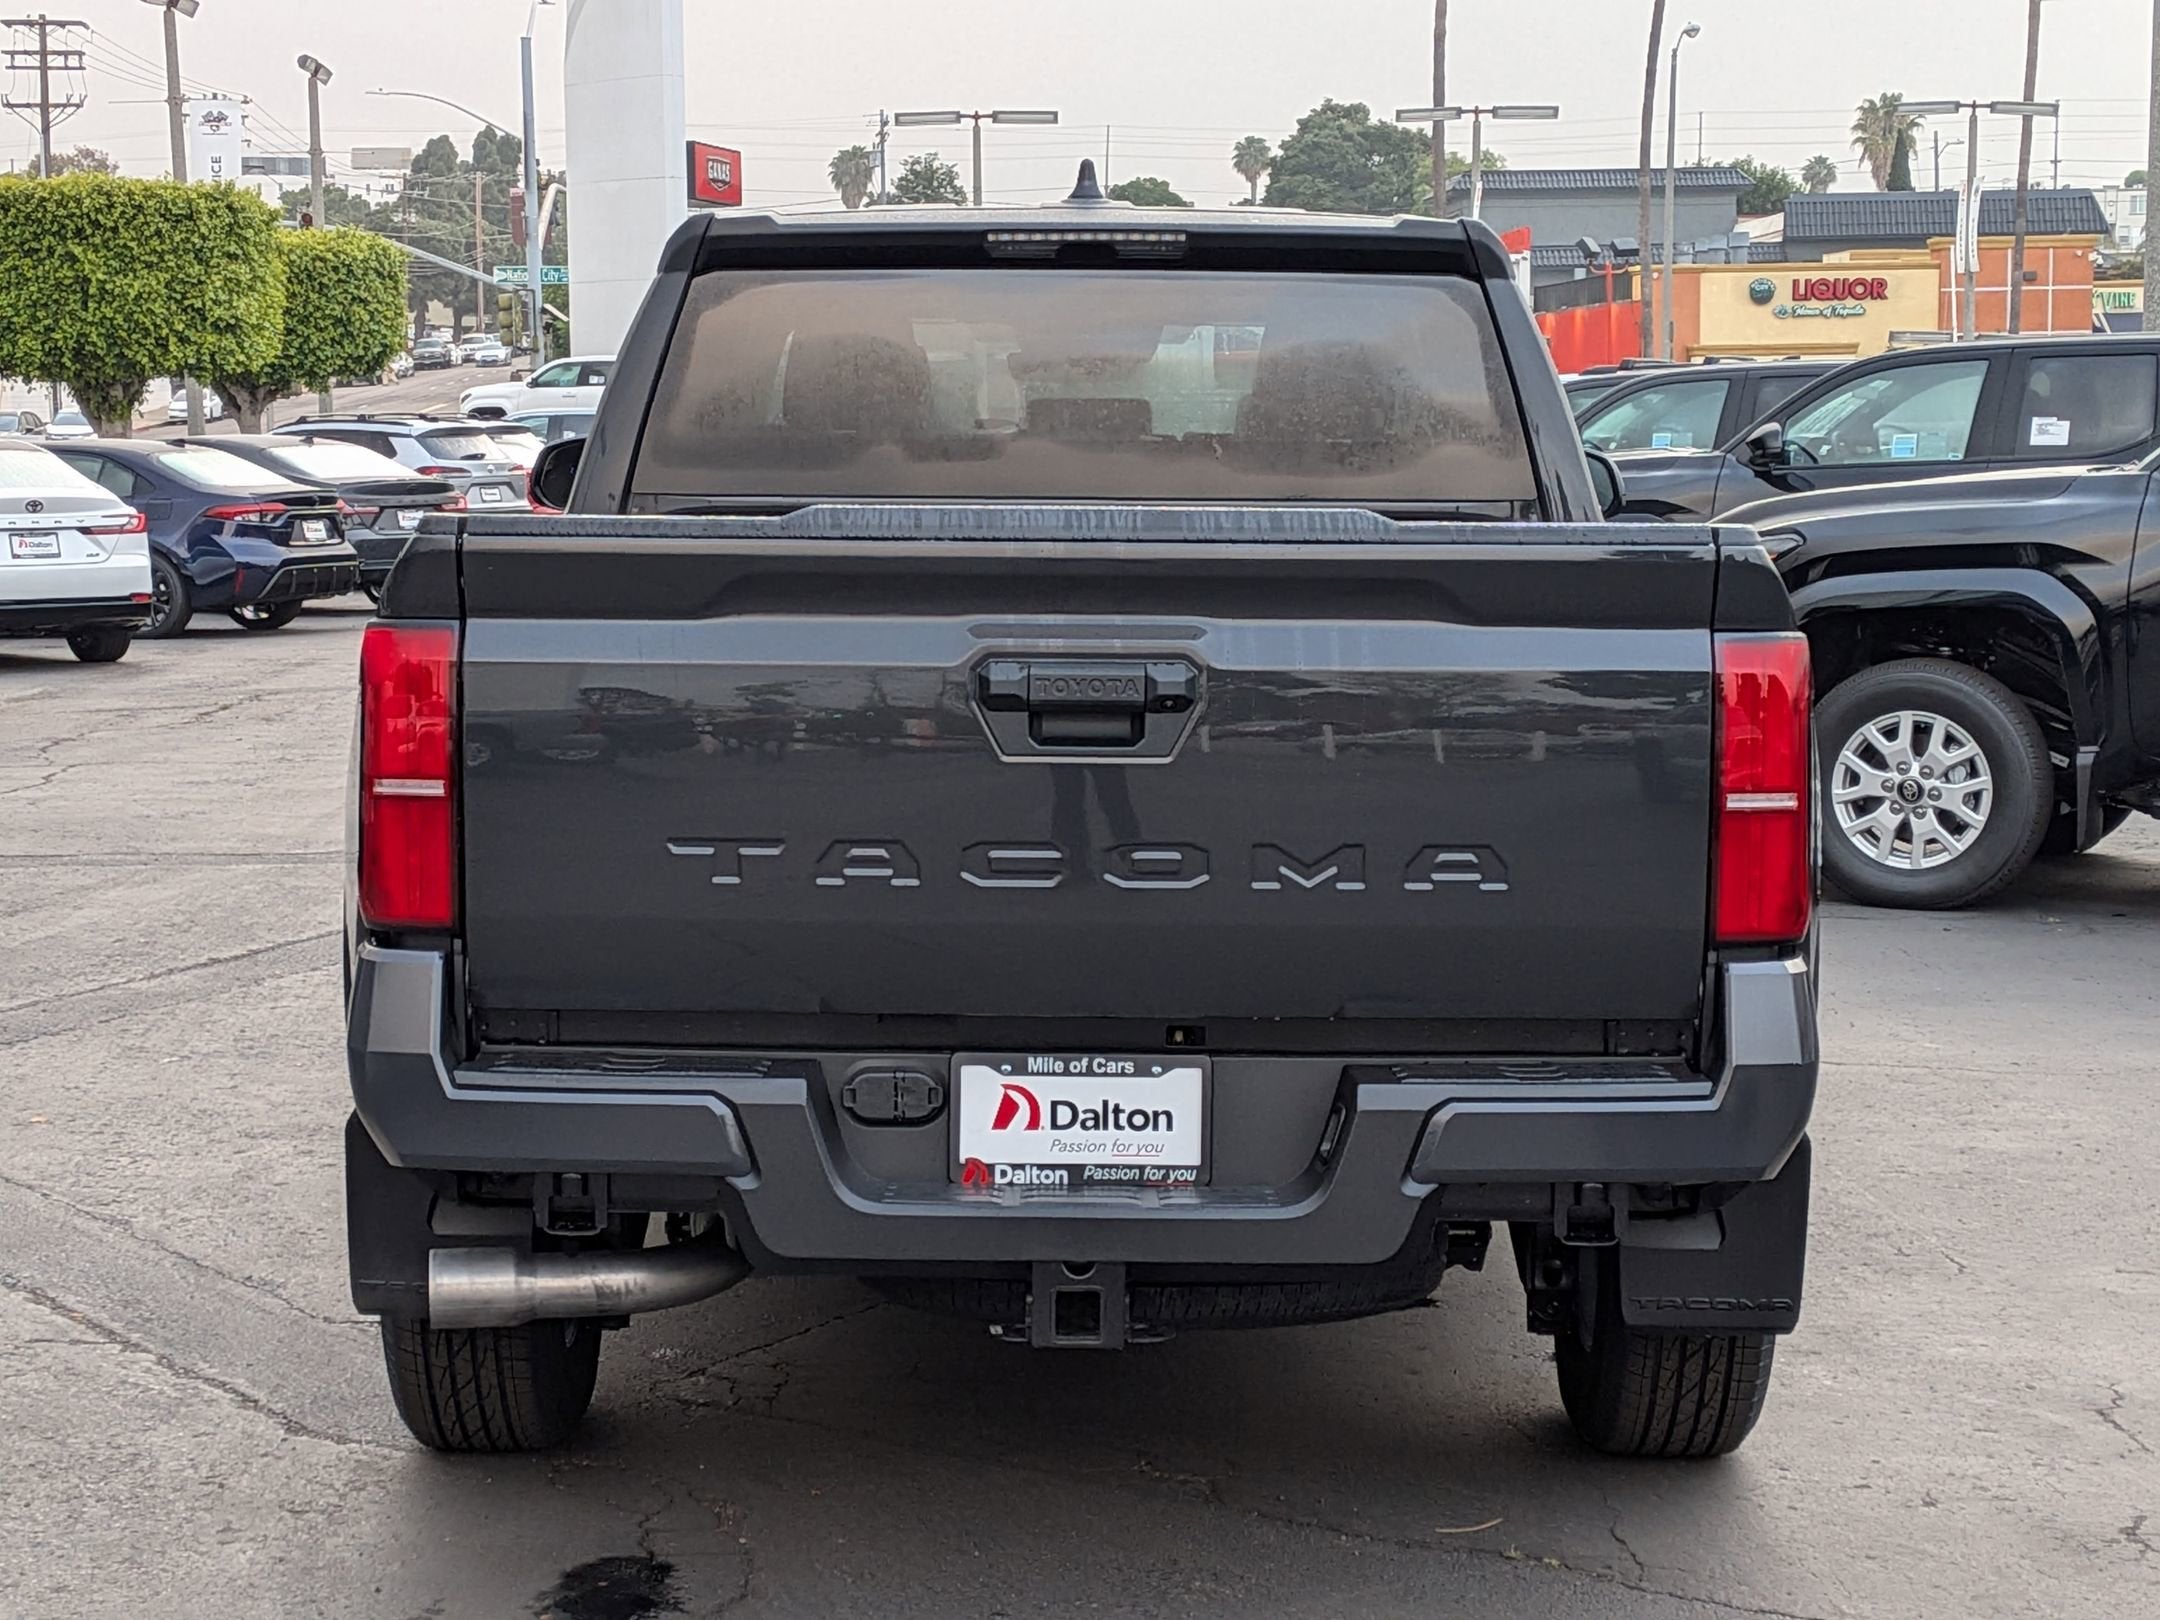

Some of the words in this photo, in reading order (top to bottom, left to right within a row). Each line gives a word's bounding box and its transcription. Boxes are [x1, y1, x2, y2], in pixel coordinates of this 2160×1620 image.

[542, 268, 559, 282] City
[1792, 277, 1888, 301] LIQUOR
[1034, 677, 1141, 698] TOYOTA
[667, 837, 1511, 892] TACOMA
[1027, 1057, 1064, 1074] Mile
[1069, 1056, 1089, 1074] of
[1092, 1057, 1135, 1074] Cars
[1050, 1099, 1174, 1132] Dalton
[1050, 1138, 1106, 1153] Passion
[1110, 1138, 1134, 1154] for
[1136, 1142, 1165, 1154] you
[994, 1164, 1069, 1184] Dalton
[1083, 1165, 1139, 1181] Passion
[1143, 1165, 1169, 1182] for
[1170, 1168, 1197, 1182] you
[1629, 1296, 1794, 1312] TACOMA
